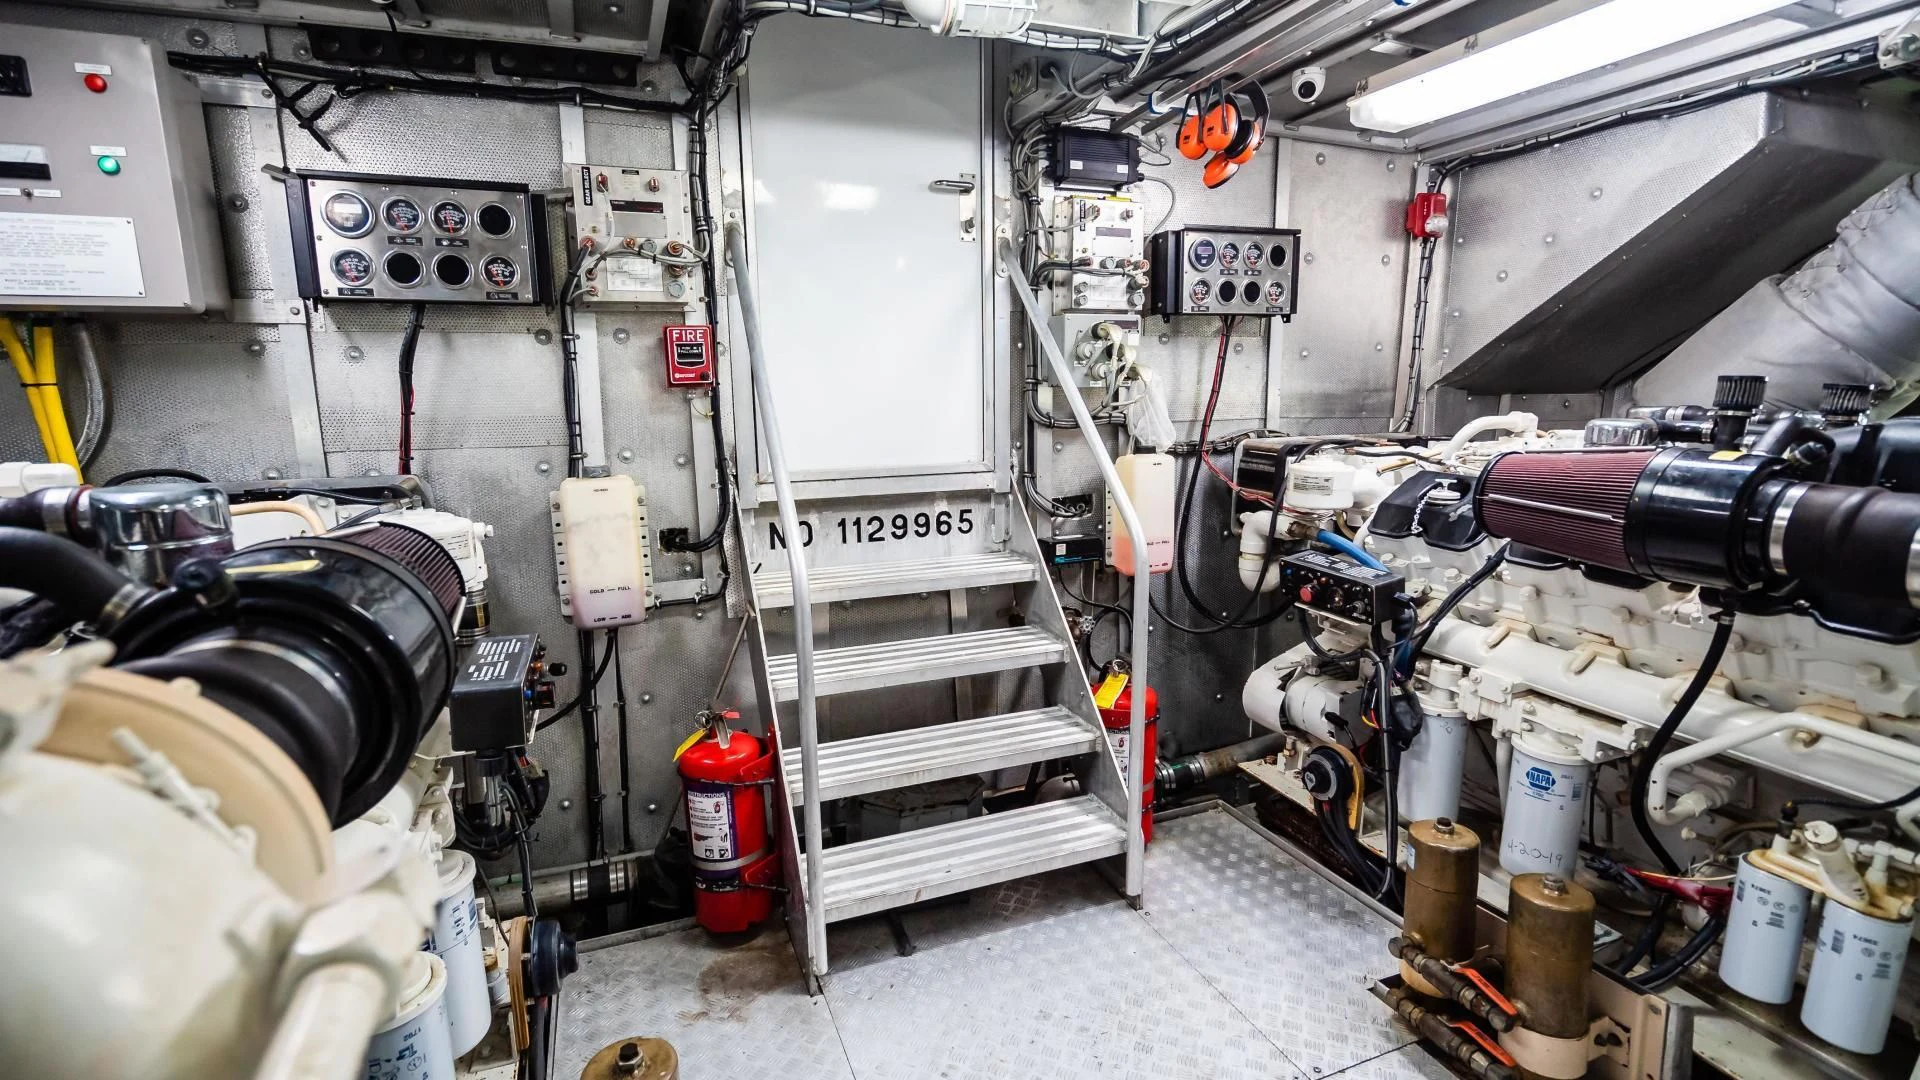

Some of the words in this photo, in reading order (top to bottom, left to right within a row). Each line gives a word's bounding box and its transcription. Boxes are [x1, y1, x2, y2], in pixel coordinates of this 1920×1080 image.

[672, 330, 705, 342] FIRE
[837, 509, 974, 544] 1129965
[1529, 771, 1551, 787] NAPA
